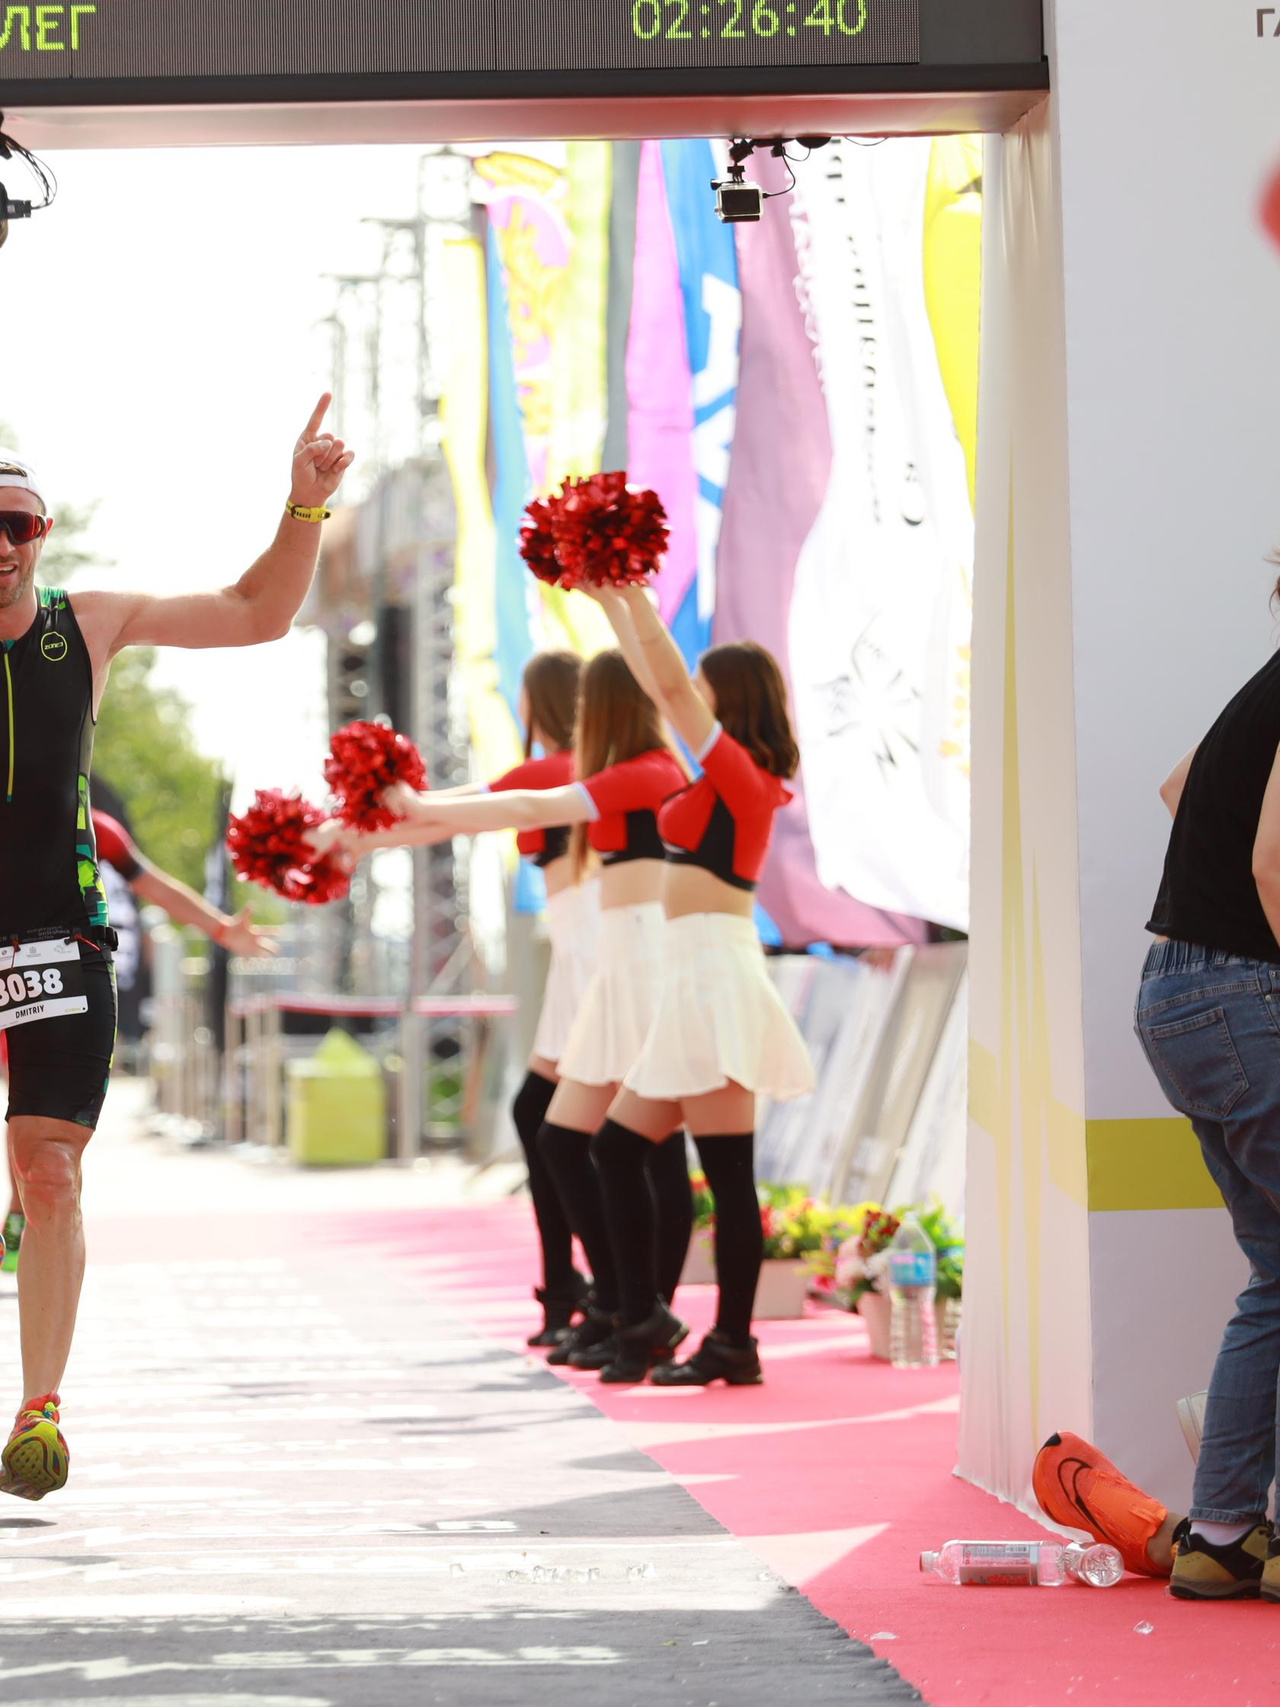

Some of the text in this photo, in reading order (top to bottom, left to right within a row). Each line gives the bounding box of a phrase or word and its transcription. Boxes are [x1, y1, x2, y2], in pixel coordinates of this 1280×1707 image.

[633, 0, 867, 40] 02:26:40
[15, 1004, 45, 1019] DMITRIY
[212, 1645, 621, 1664] STAR
